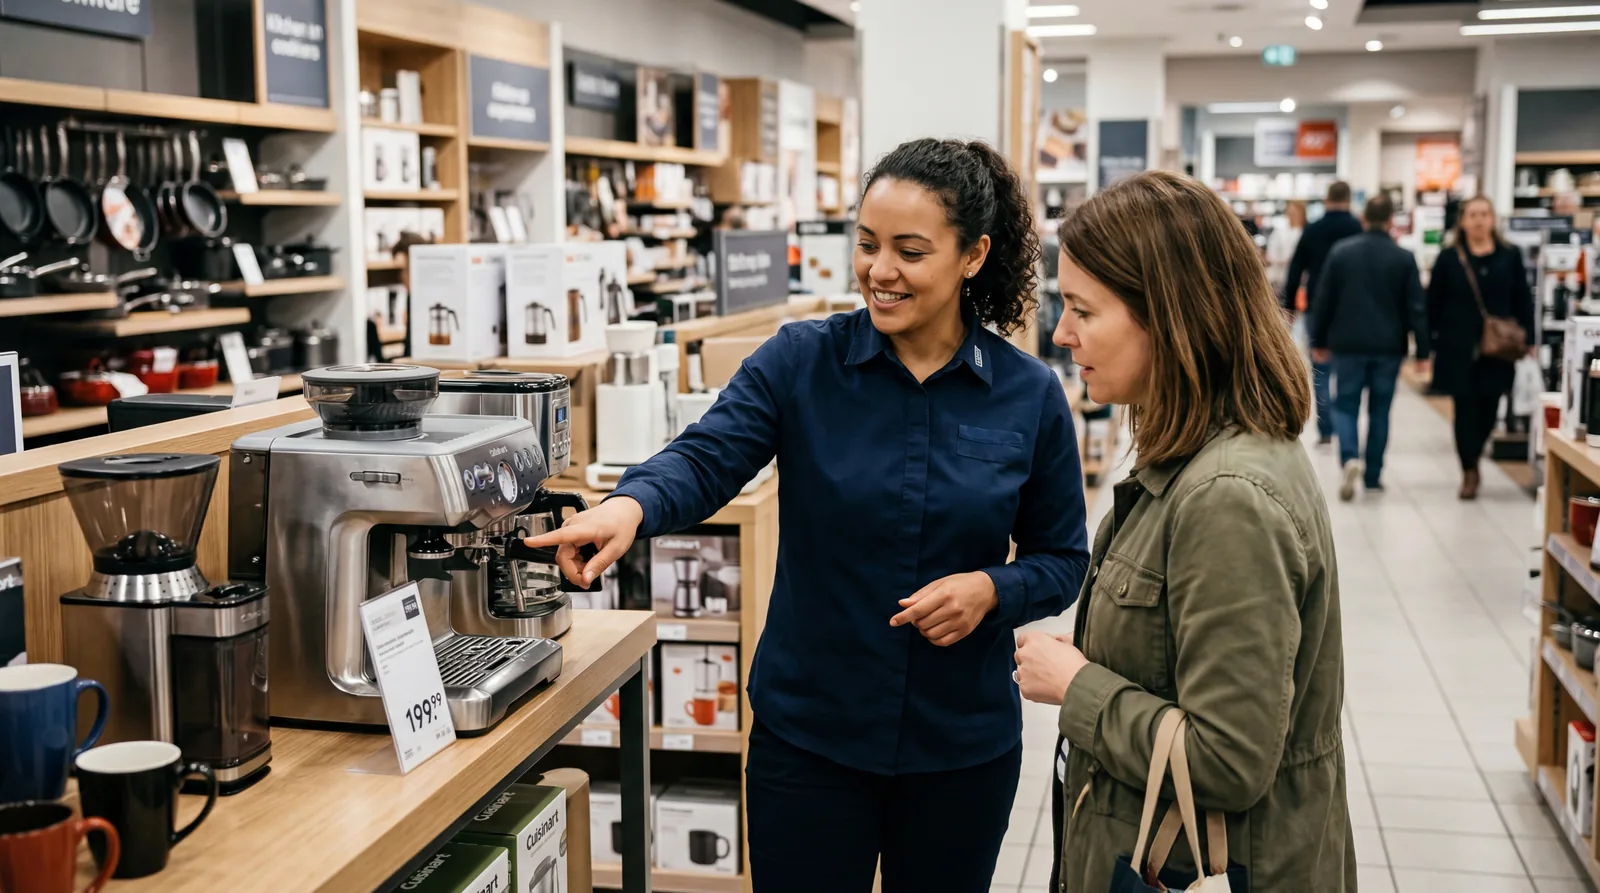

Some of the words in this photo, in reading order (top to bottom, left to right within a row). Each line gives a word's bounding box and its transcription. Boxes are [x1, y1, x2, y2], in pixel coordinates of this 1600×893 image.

[474, 791, 516, 822] Cuisinart
[526, 810, 559, 850] Cuisinart
[400, 853, 451, 890] Cuisinart
